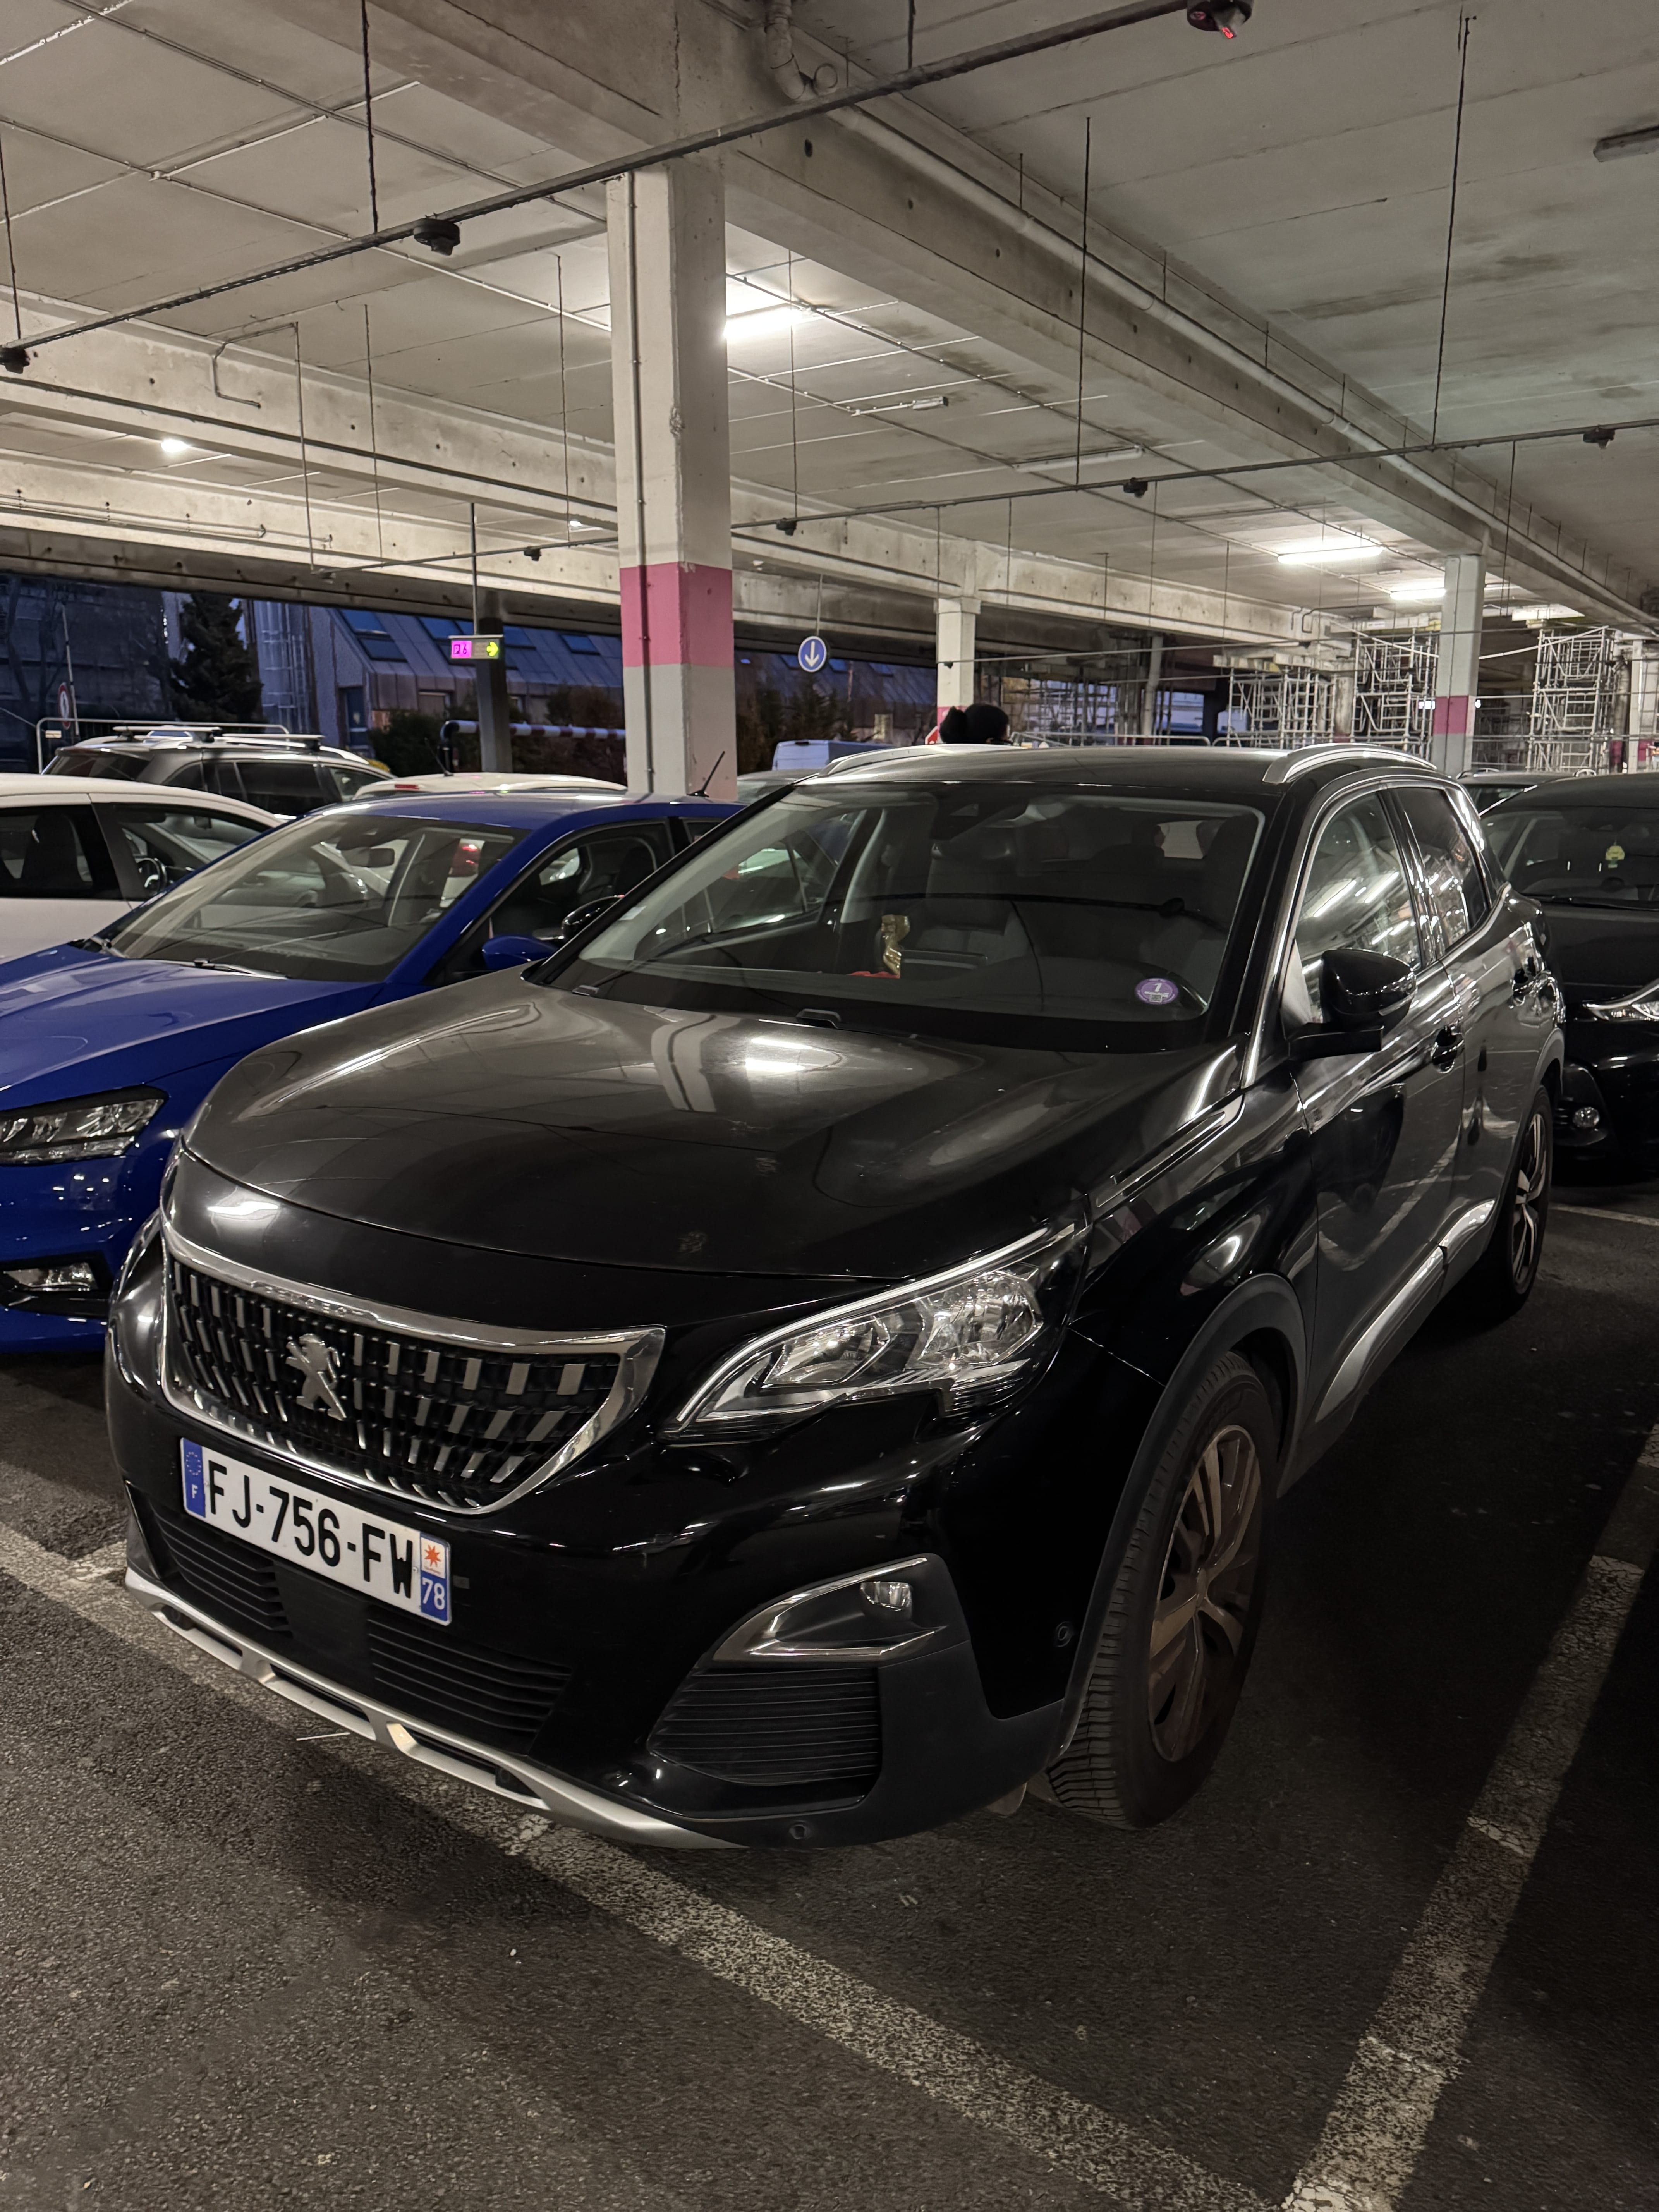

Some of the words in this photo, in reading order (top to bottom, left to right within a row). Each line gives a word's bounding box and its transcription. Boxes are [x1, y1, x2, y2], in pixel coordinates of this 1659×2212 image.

[1153, 983, 1162, 992] 1
[192, 1484, 198, 1499] F
[208, 1460, 414, 1598] FJ-756-FW
[422, 1577, 445, 1610] 78
